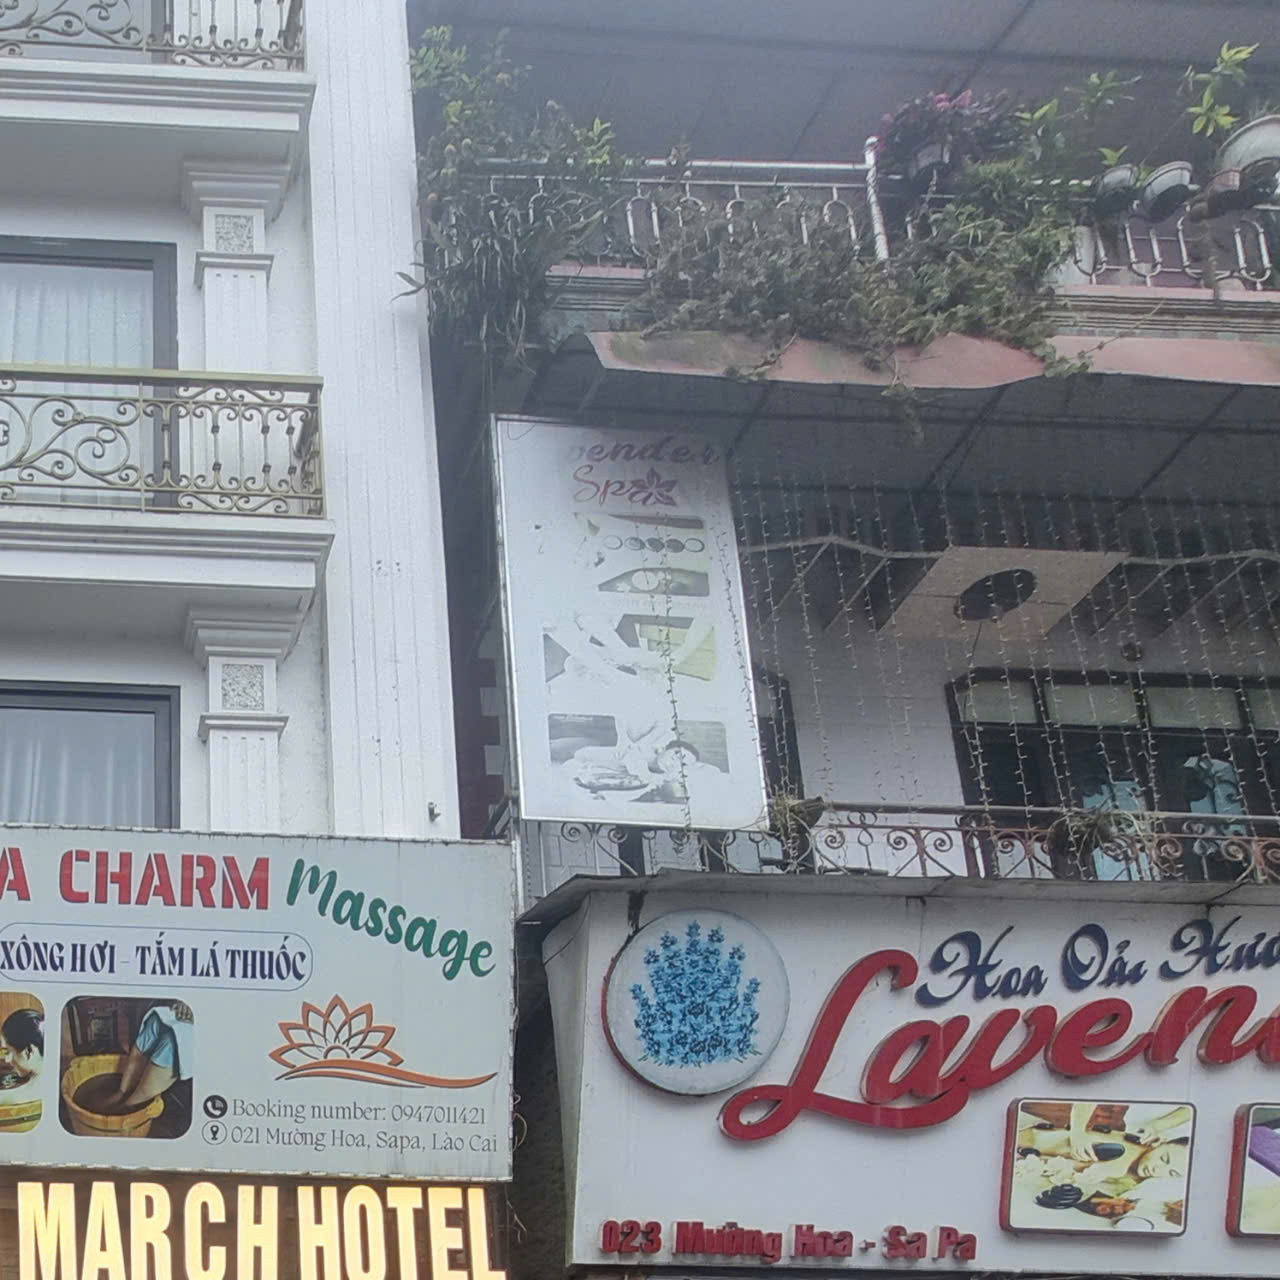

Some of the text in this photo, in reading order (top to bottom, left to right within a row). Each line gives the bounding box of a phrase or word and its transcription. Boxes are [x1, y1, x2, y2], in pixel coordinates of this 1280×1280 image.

[59, 849, 270, 910] CHARM
[286, 858, 497, 981] Massage
[0, 933, 64, 974] XÔNG
[70, 937, 116, 975] HƠI
[135, 931, 187, 977] TẮM
[190, 941, 220, 978] LÁ
[226, 935, 306, 981] THUỐC
[914, 926, 1049, 1008] Hoa
[719, 947, 1280, 1141] Laven
[233, 1099, 486, 1126] Booking number: 0947011421
[231, 1126, 497, 1153] 021 Mường Hoa, Sapa, Lào Cai
[599, 1220, 662, 1255] 023
[790, 1224, 854, 1258] Hoa
[881, 1225, 927, 1260] Sa
[933, 1225, 977, 1261] Pa
